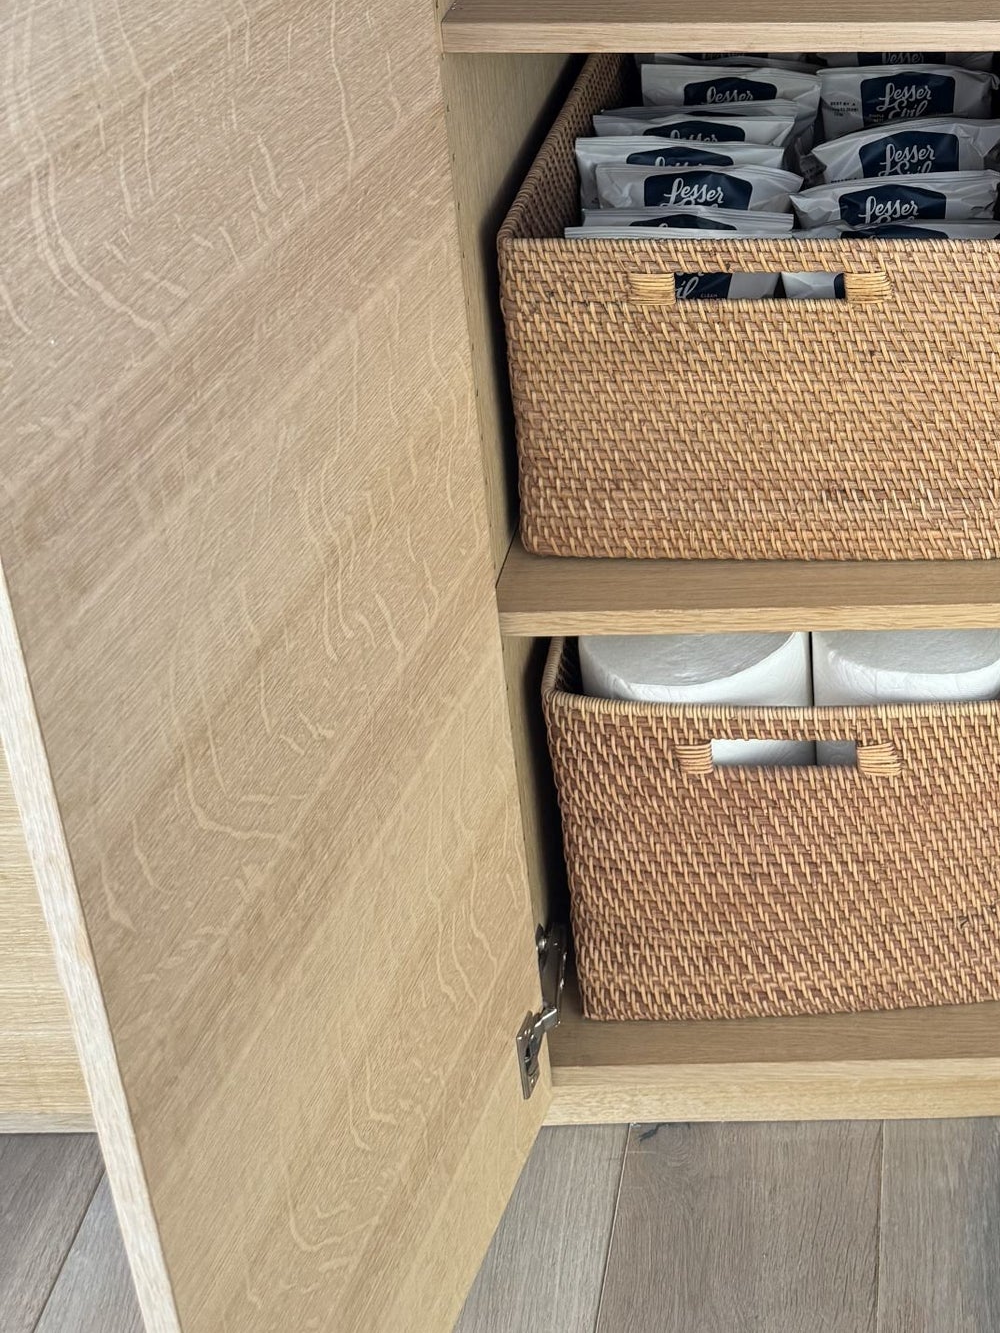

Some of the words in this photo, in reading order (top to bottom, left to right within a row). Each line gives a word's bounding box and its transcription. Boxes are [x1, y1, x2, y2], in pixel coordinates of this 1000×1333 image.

[876, 82, 932, 112] Lesser
[878, 143, 936, 177] Lesser
[664, 177, 724, 207] Lesser
[858, 196, 919, 224] Lesser
[676, 276, 699, 299] il
